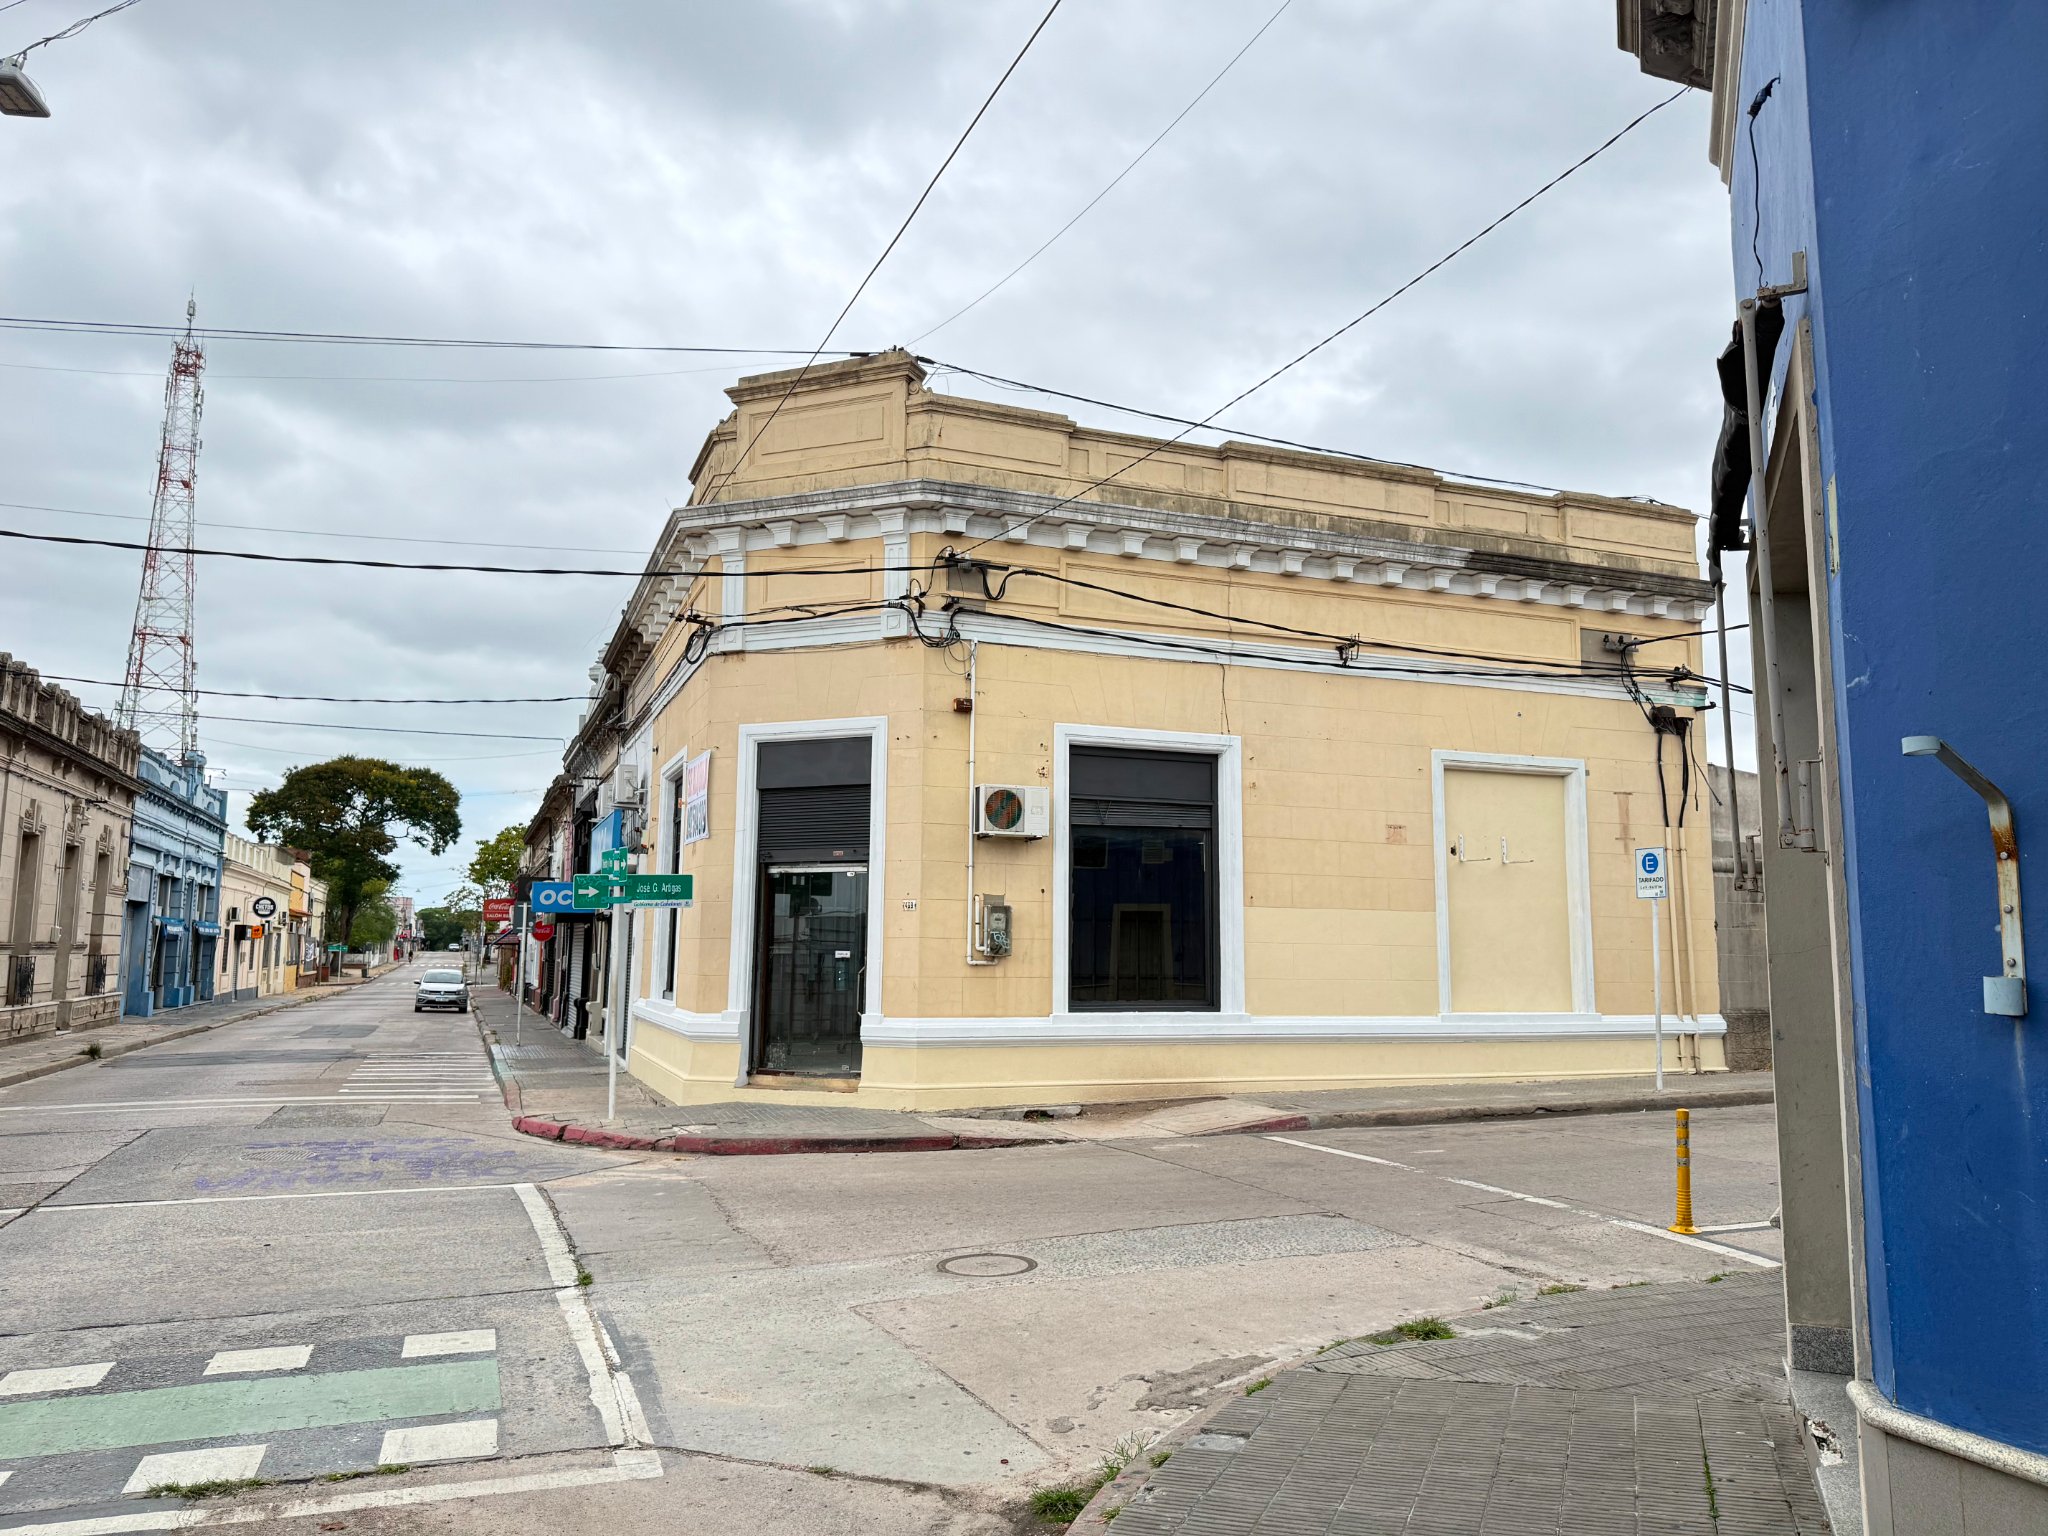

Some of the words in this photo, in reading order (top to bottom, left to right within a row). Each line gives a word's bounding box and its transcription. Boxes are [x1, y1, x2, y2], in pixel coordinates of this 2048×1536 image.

[1645, 856, 1655, 871] E
[637, 882, 650, 893] José
[661, 883, 681, 894] Artigas
